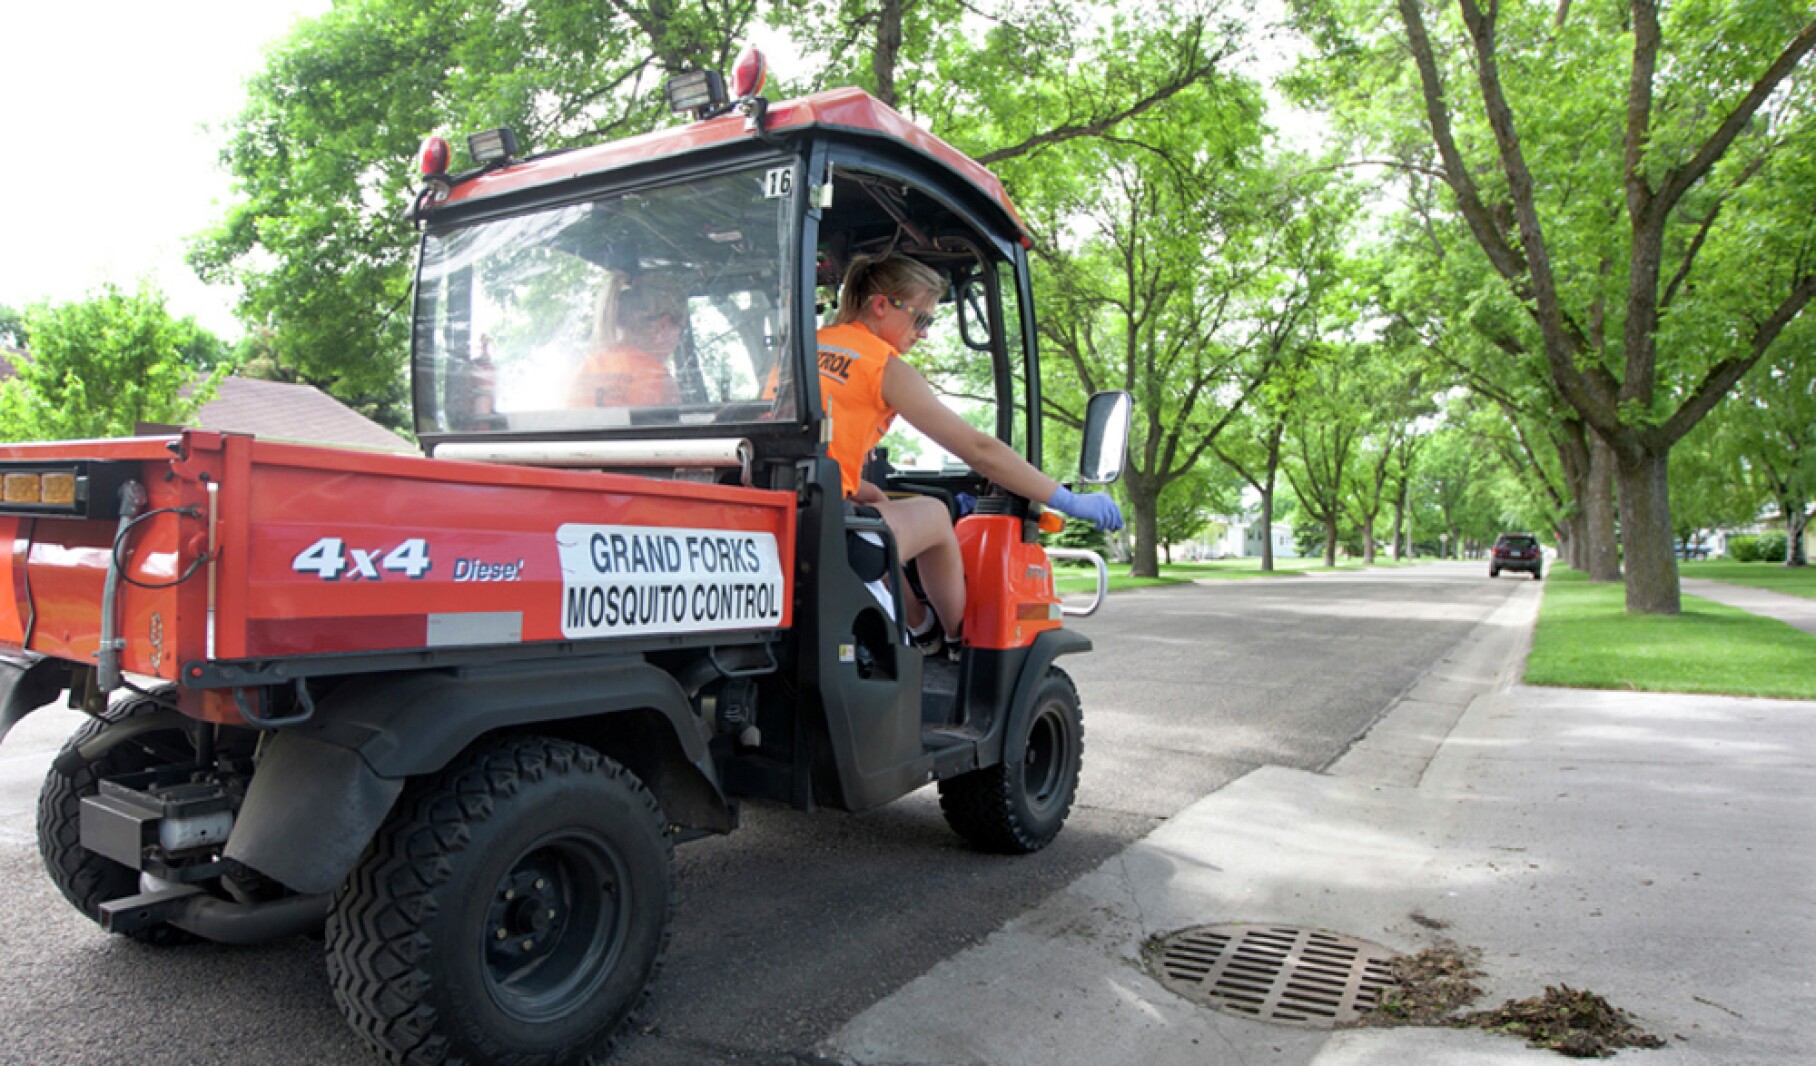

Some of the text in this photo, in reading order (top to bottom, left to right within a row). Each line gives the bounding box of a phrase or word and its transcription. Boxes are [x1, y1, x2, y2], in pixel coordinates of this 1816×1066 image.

[770, 169, 791, 195] 16
[292, 537, 433, 581] 4x4
[453, 557, 524, 582] Diesel
[590, 532, 760, 574] GRAND FORKS
[567, 582, 779, 629] MOSQUITO CONTROL
